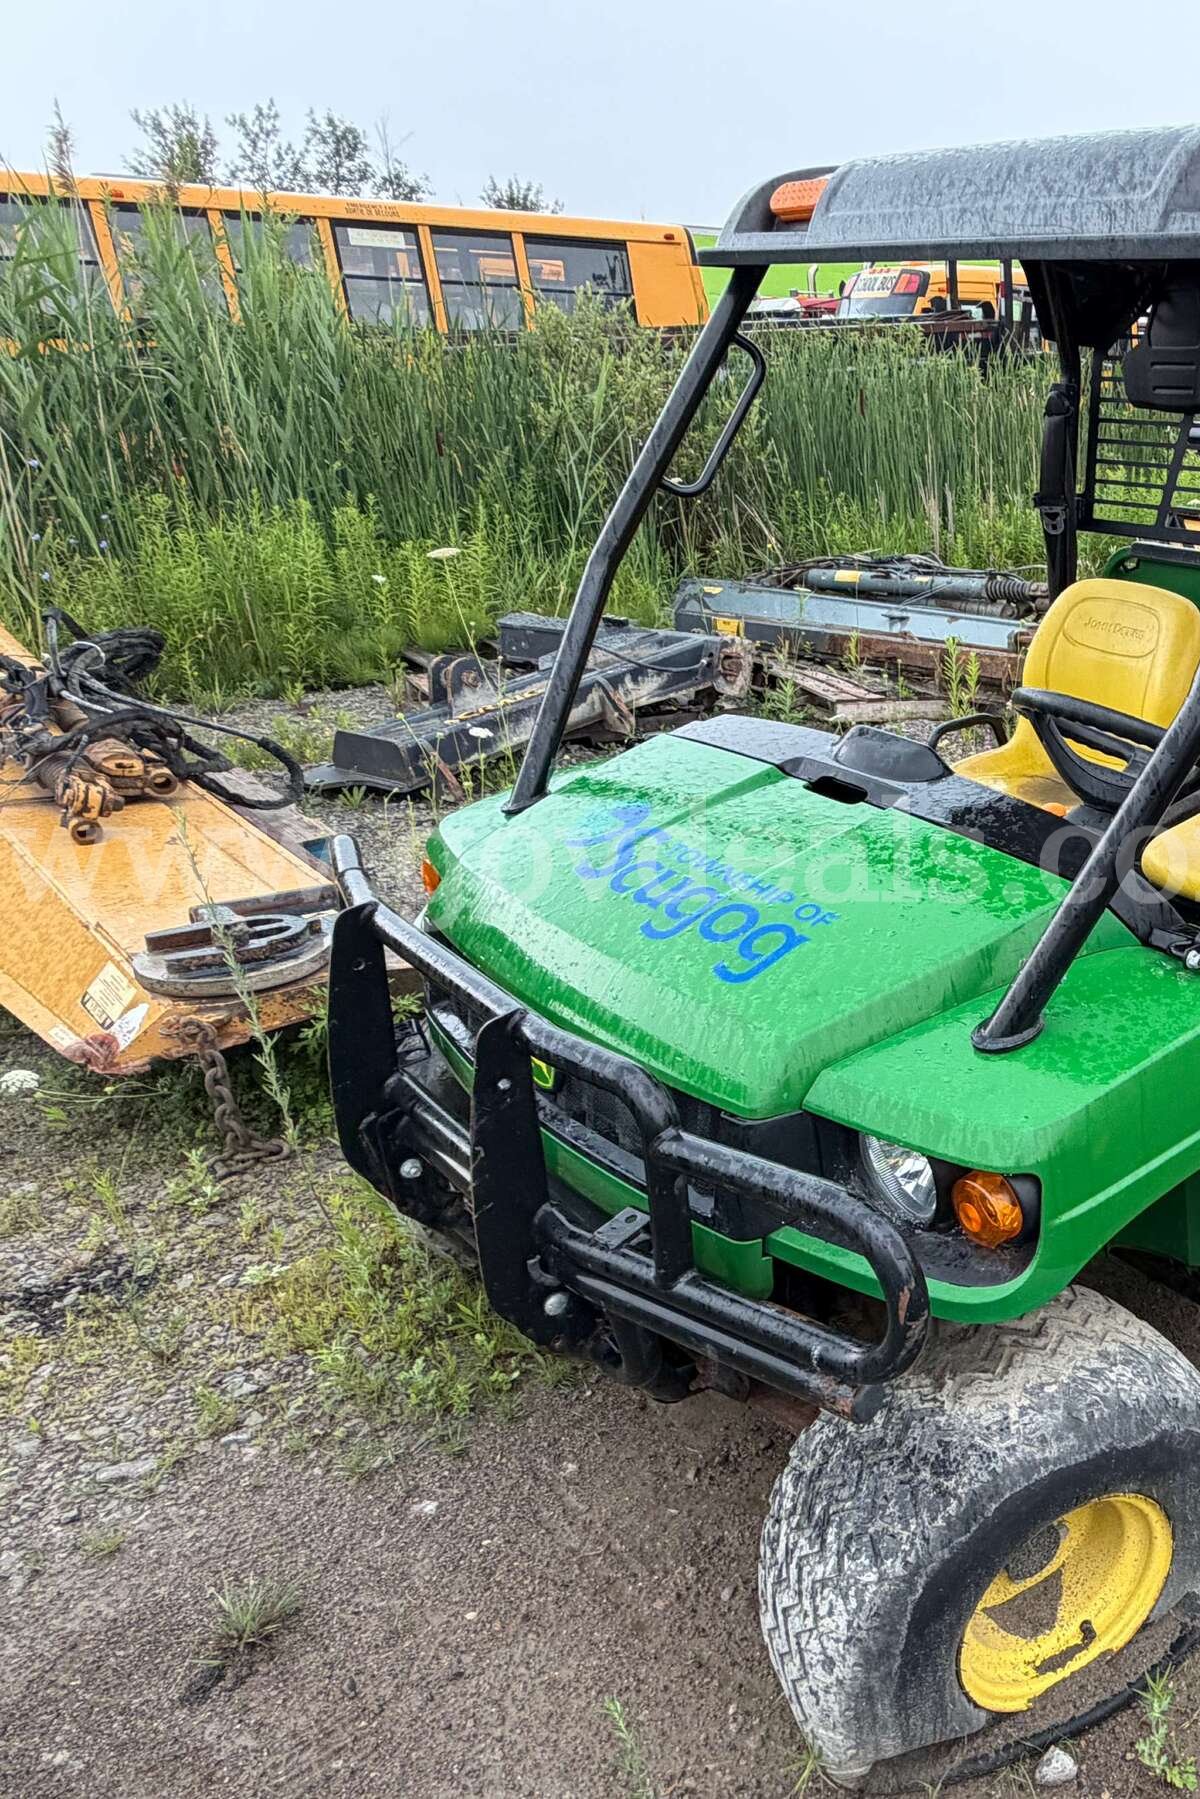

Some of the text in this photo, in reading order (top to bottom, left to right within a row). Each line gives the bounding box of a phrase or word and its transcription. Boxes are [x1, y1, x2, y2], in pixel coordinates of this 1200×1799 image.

[878, 275, 897, 290] BUS
[574, 828, 811, 984] Scugog
[667, 842, 840, 928] TOWNSHIP OF
